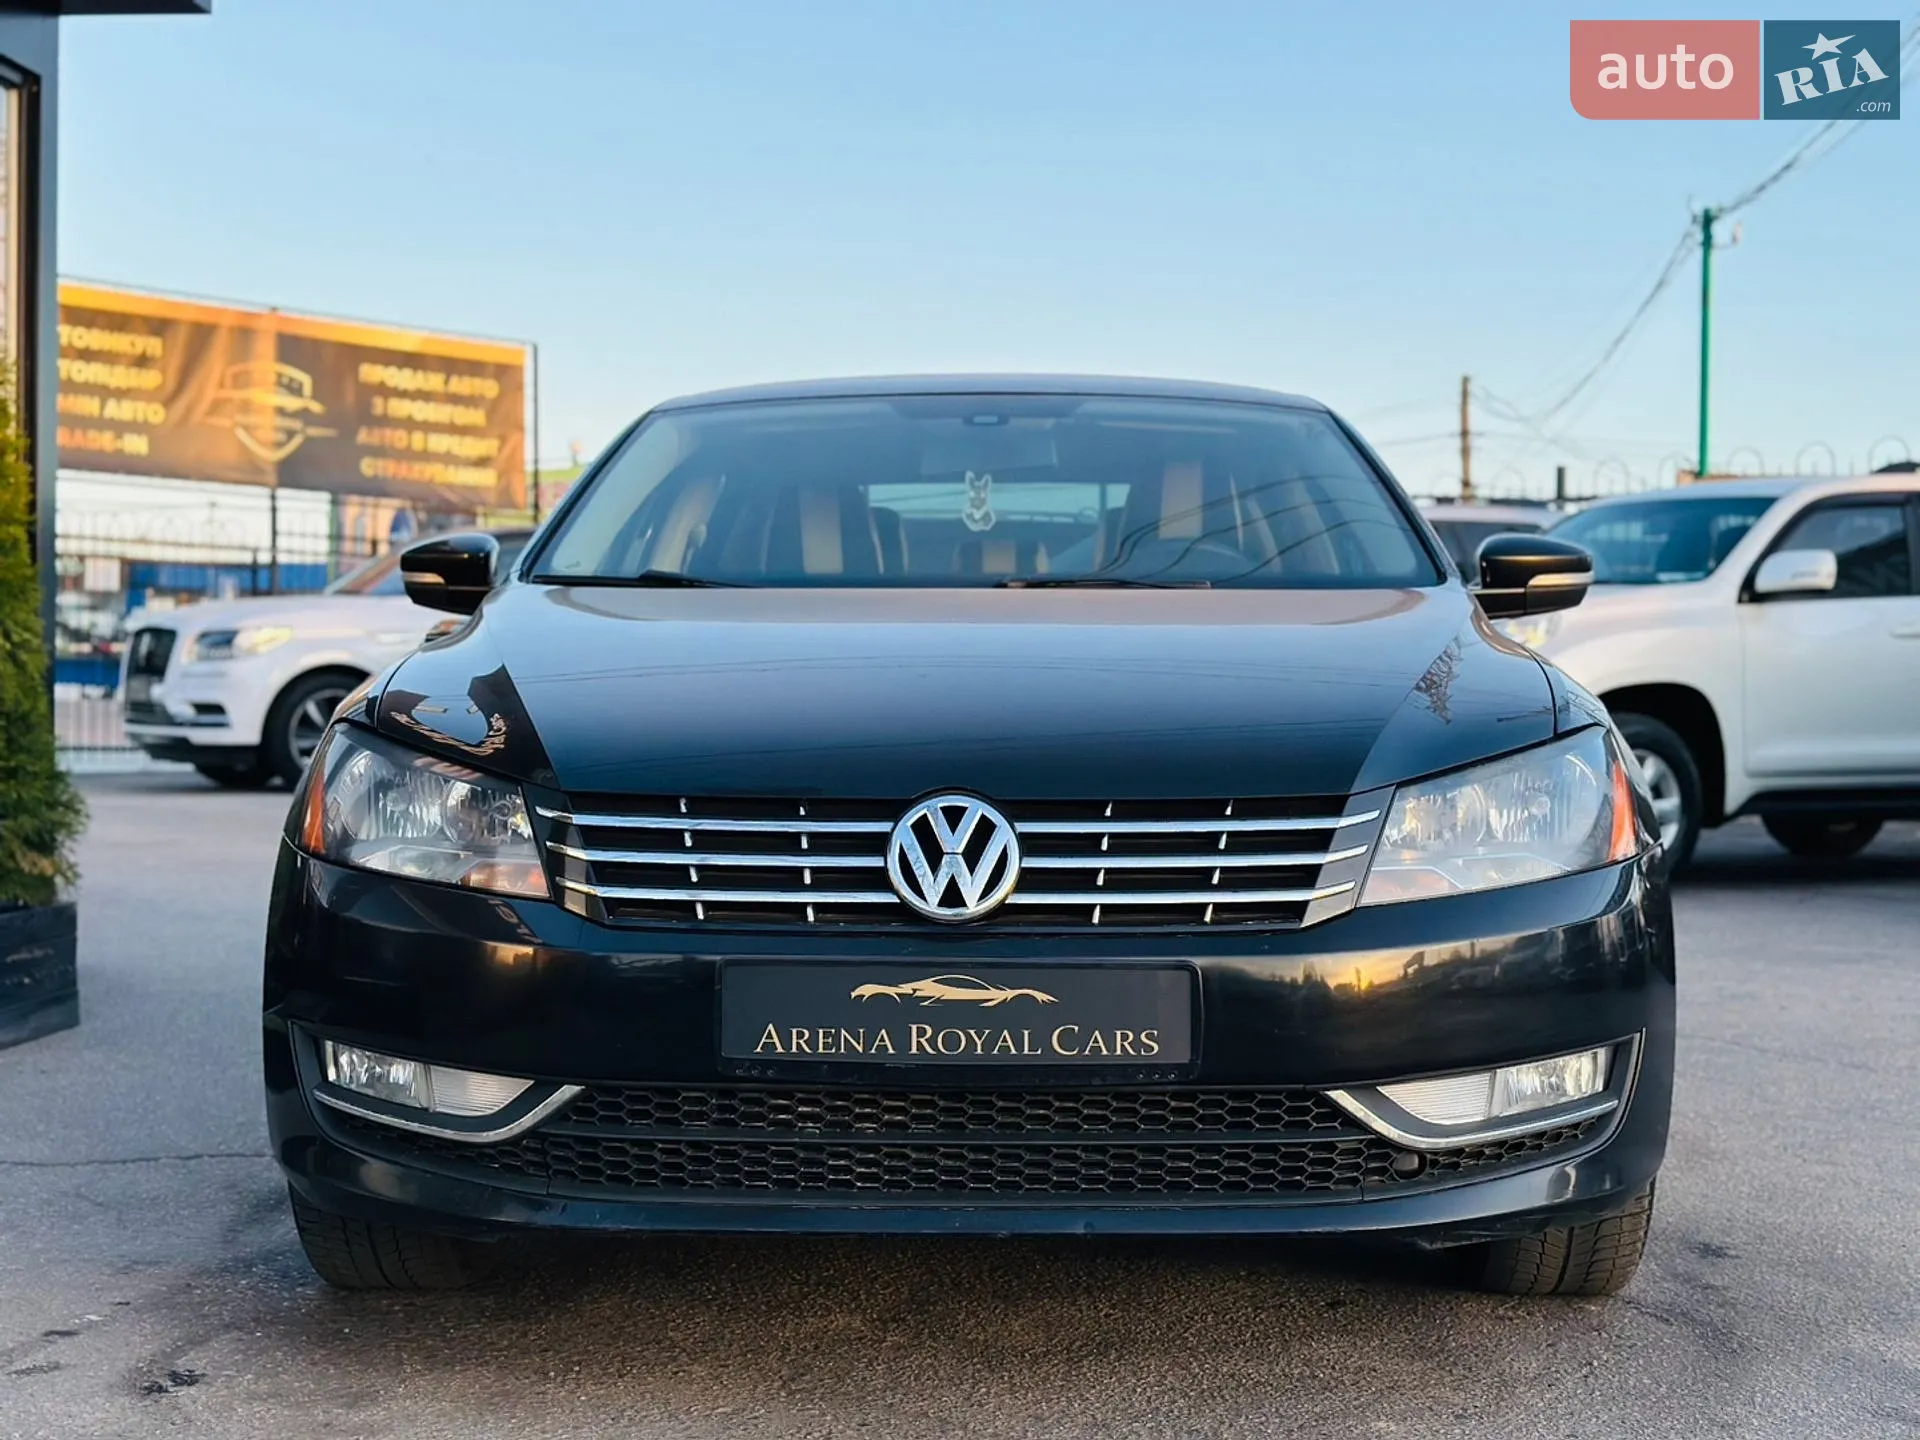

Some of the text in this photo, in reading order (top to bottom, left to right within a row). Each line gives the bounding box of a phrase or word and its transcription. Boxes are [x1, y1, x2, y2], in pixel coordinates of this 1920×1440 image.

[754, 1022, 1159, 1056] ARENA ROYAL CARS
